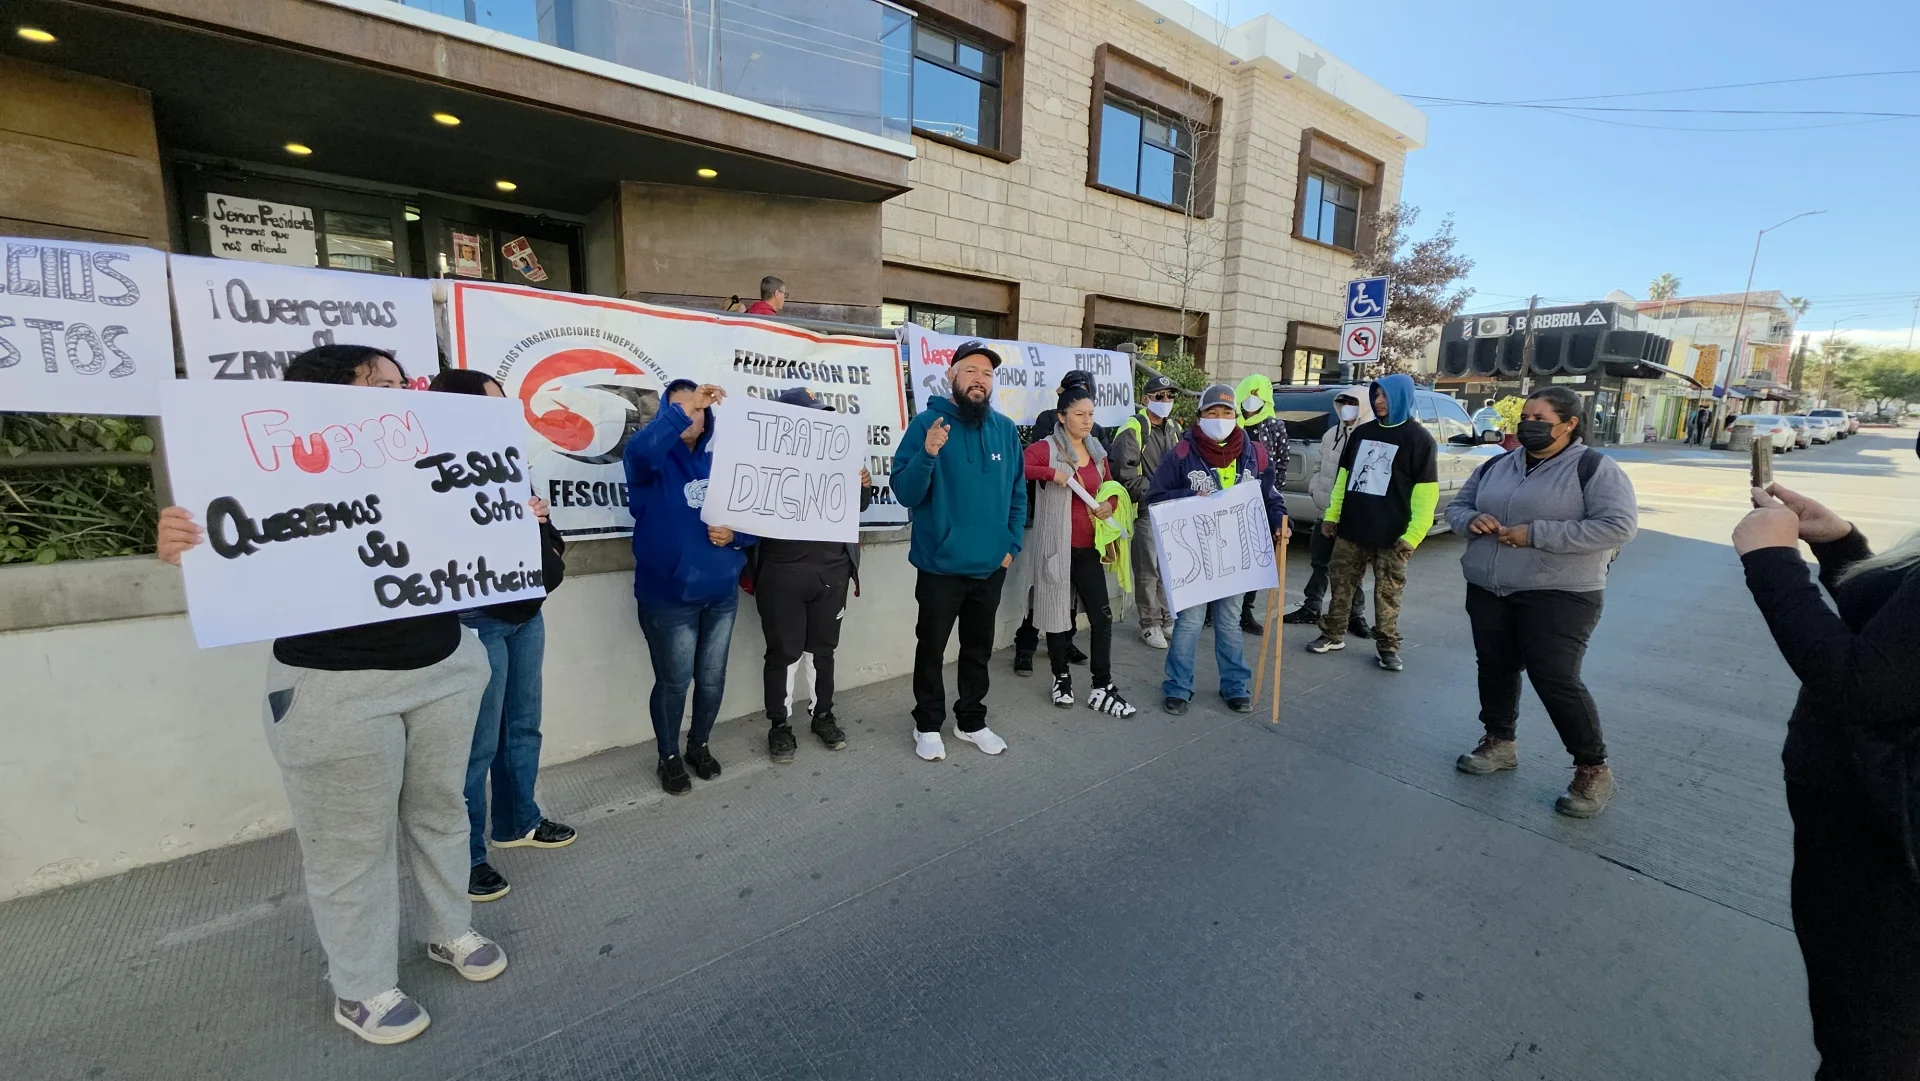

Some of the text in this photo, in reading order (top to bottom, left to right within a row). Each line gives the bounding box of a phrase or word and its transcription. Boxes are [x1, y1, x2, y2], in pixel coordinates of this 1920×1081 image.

[258, 205, 314, 231] Presidente
[220, 224, 289, 241] queremos que
[222, 241, 242, 251] nos
[514, 344, 524, 353] Y
[521, 326, 600, 349] ORGANIZACIONES
[603, 331, 667, 381] INDEPENDIENTES
[1027, 346, 1046, 367] EL
[1074, 353, 1111, 376] FUERA
[734, 349, 871, 386] FEDERACIÓN DE
[995, 367, 1046, 388] MANDO DE
[748, 412, 850, 460] TRATO
[727, 463, 847, 522] DIGNO
[470, 487, 523, 526] Soto
